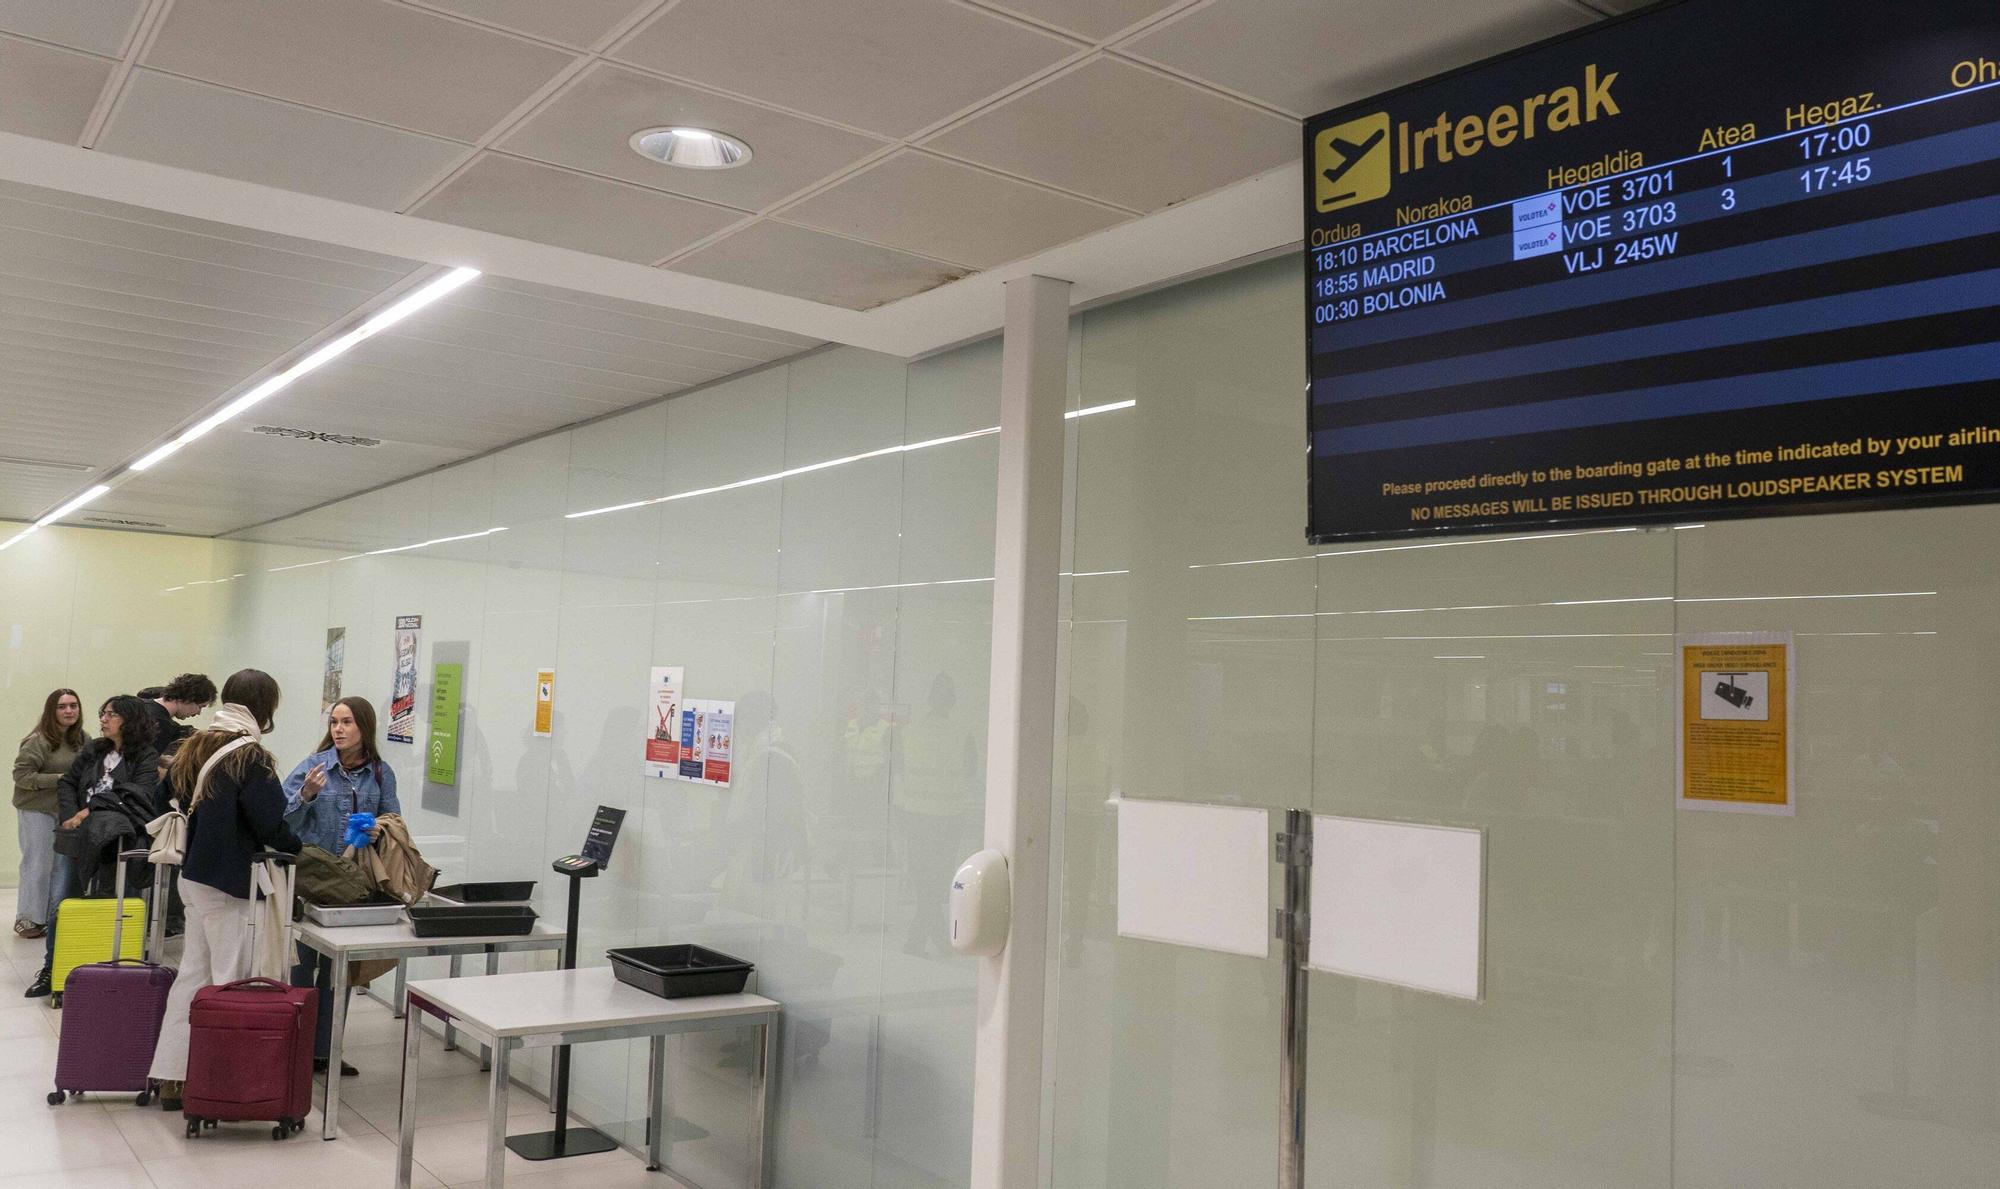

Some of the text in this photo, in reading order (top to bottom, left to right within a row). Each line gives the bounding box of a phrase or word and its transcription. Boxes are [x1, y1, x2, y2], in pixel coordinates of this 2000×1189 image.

[1312, 57, 2000, 247] Ordua Norakoa Hegaldia Atea Hegaz. Oh
[1399, 64, 1621, 174] Irteerak
[1315, 123, 1870, 272] 18:10 BARCELONA VOLOTEA VOE 3701 1 17:00
[1315, 157, 1871, 298] 18:55 MADRID VOLOTEA VOE 3703 3 17:45
[1315, 232, 1678, 324] 00:30 BOLONIA VLJ 245W
[1382, 482, 1422, 496] Please
[1424, 476, 1476, 495] proceed
[1479, 471, 1528, 488] directly
[1532, 470, 1546, 483] to
[1550, 466, 1572, 481] the
[1576, 460, 1642, 479] boarding
[1646, 457, 1680, 477] gate
[1684, 456, 1701, 470] at
[1704, 453, 1731, 468] the
[1735, 449, 1773, 465] time
[1778, 438, 1861, 462] indicated
[1867, 437, 1890, 457] by
[1896, 433, 1943, 454] your
[1411, 465, 1964, 521] NO MESSAGES WILL BE ISSUED THROUGH LOUDSPEAKER SYSTEM
